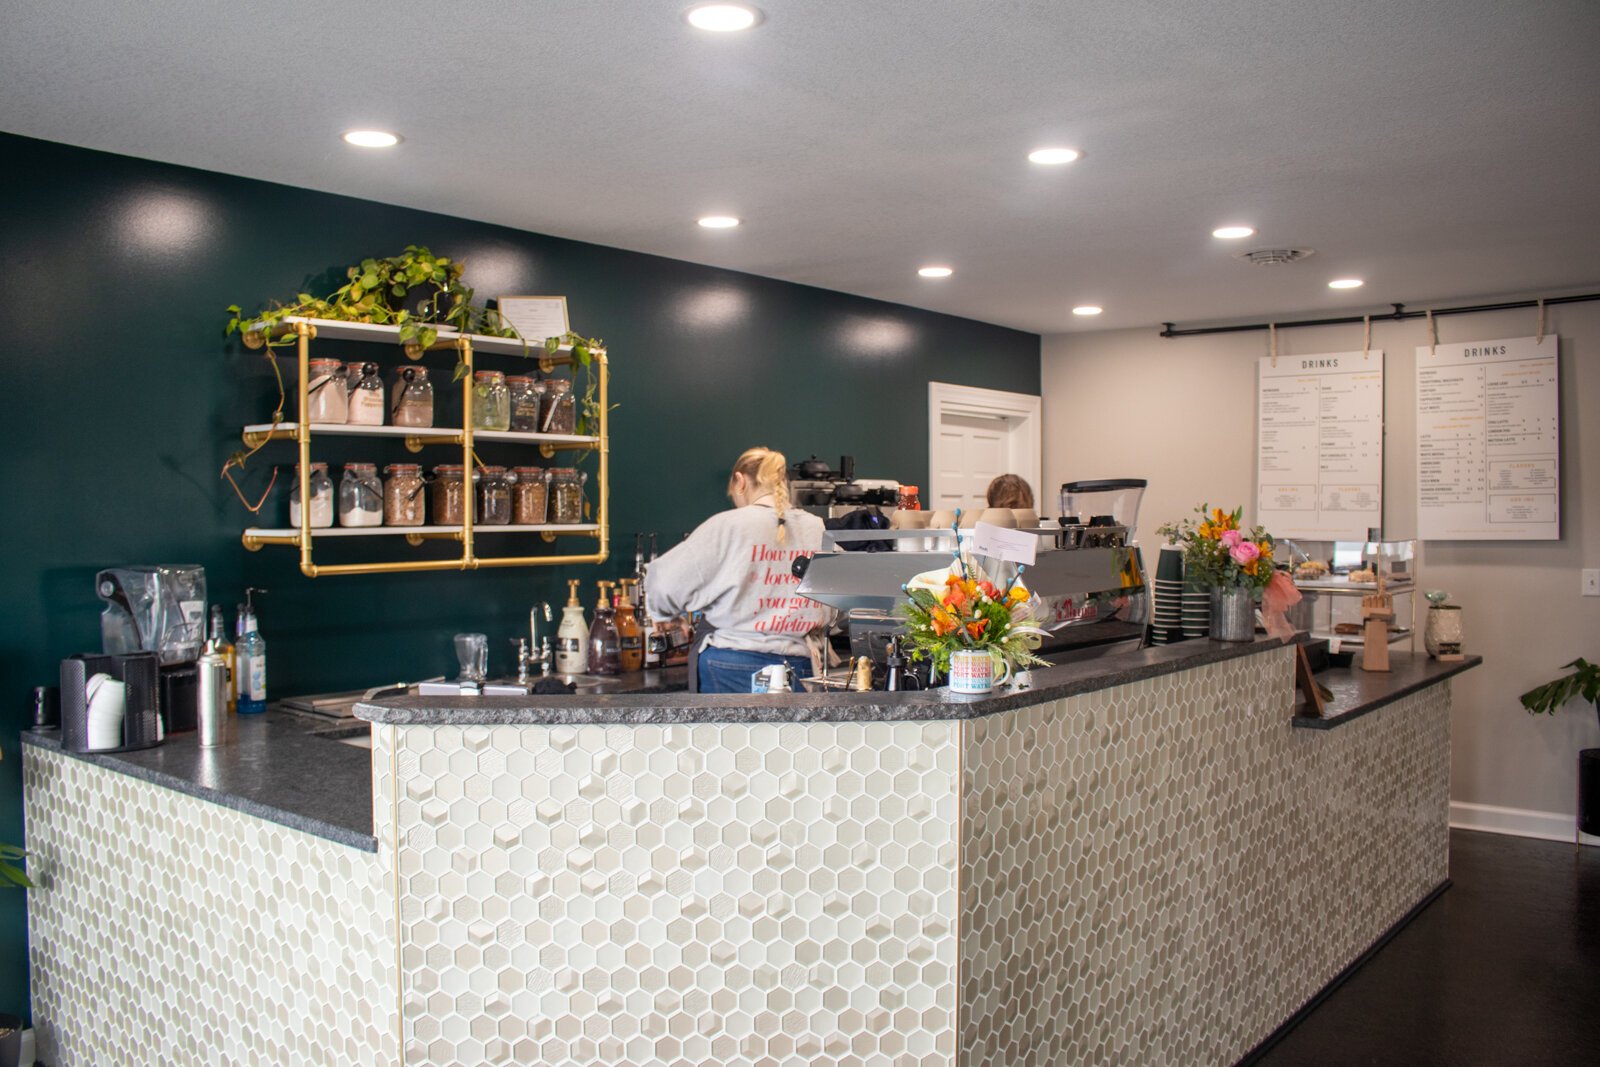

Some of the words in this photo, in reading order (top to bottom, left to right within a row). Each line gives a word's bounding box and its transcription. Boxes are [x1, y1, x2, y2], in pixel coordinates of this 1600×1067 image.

[1464, 346, 1506, 357] DRINKS
[1302, 359, 1338, 369] DRINKS
[751, 544, 786, 562] How
[753, 597, 787, 616] you
[754, 620, 766, 632] a
[769, 615, 817, 634] lifetim
